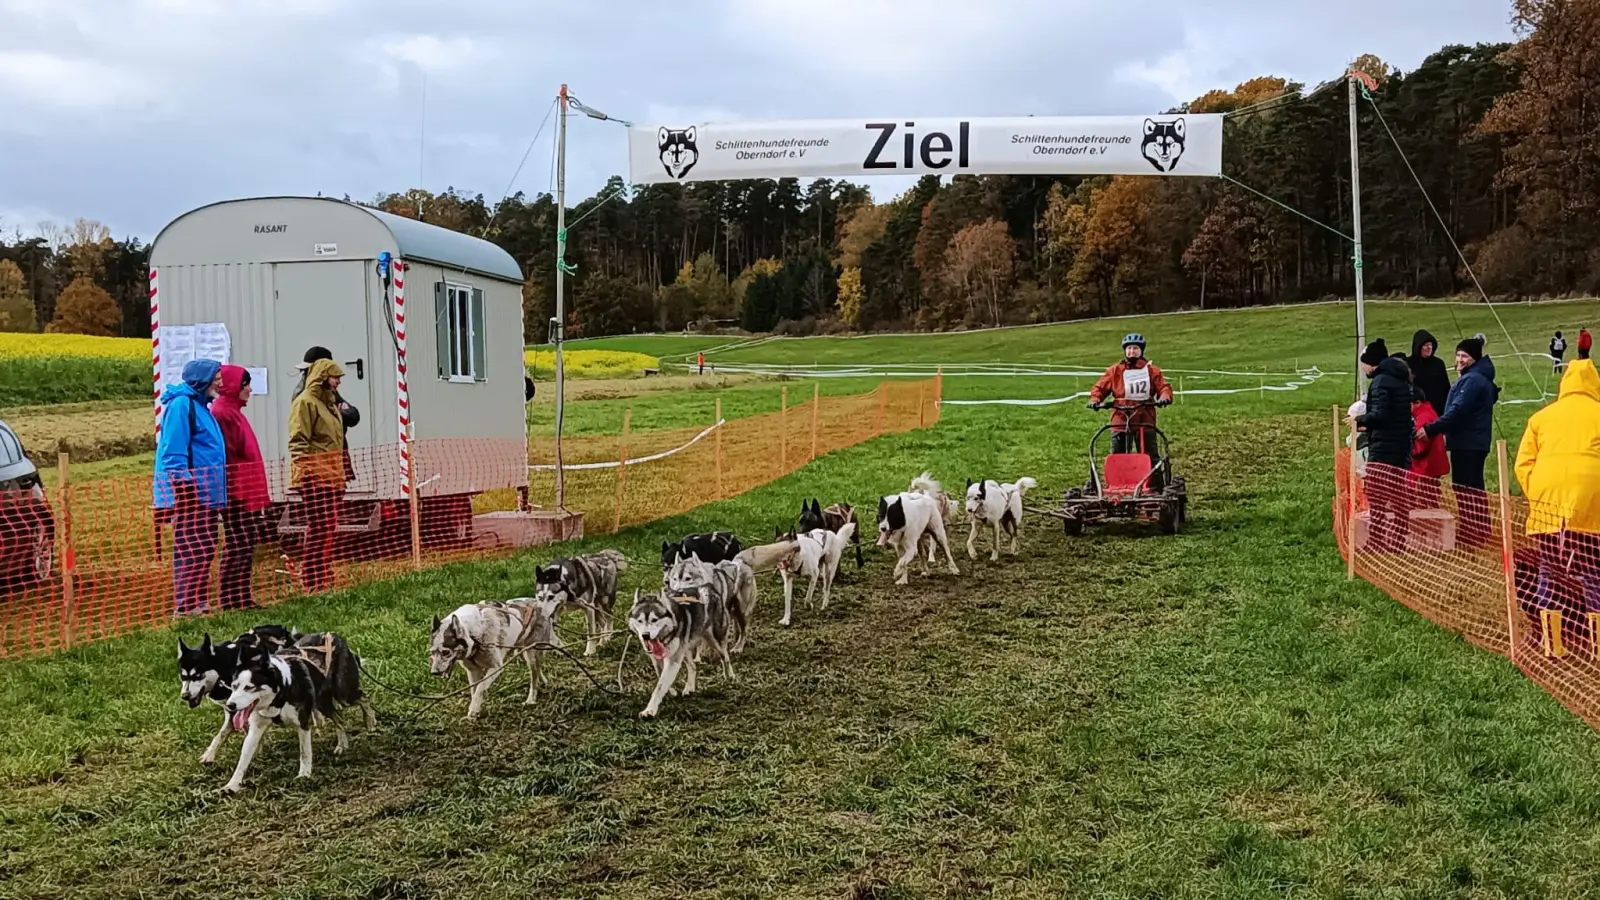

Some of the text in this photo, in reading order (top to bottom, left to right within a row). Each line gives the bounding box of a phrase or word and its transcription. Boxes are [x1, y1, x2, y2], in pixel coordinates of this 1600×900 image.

[715, 138, 829, 150] Schlittenhundefreunde
[1010, 134, 1132, 144] Schlittenhundefreunde
[863, 121, 969, 169] Ziel
[1032, 145, 1088, 155] Oberndorf
[735, 149, 787, 160] Oberndorf
[254, 224, 287, 234] RASANT
[1129, 381, 1146, 394] 112
